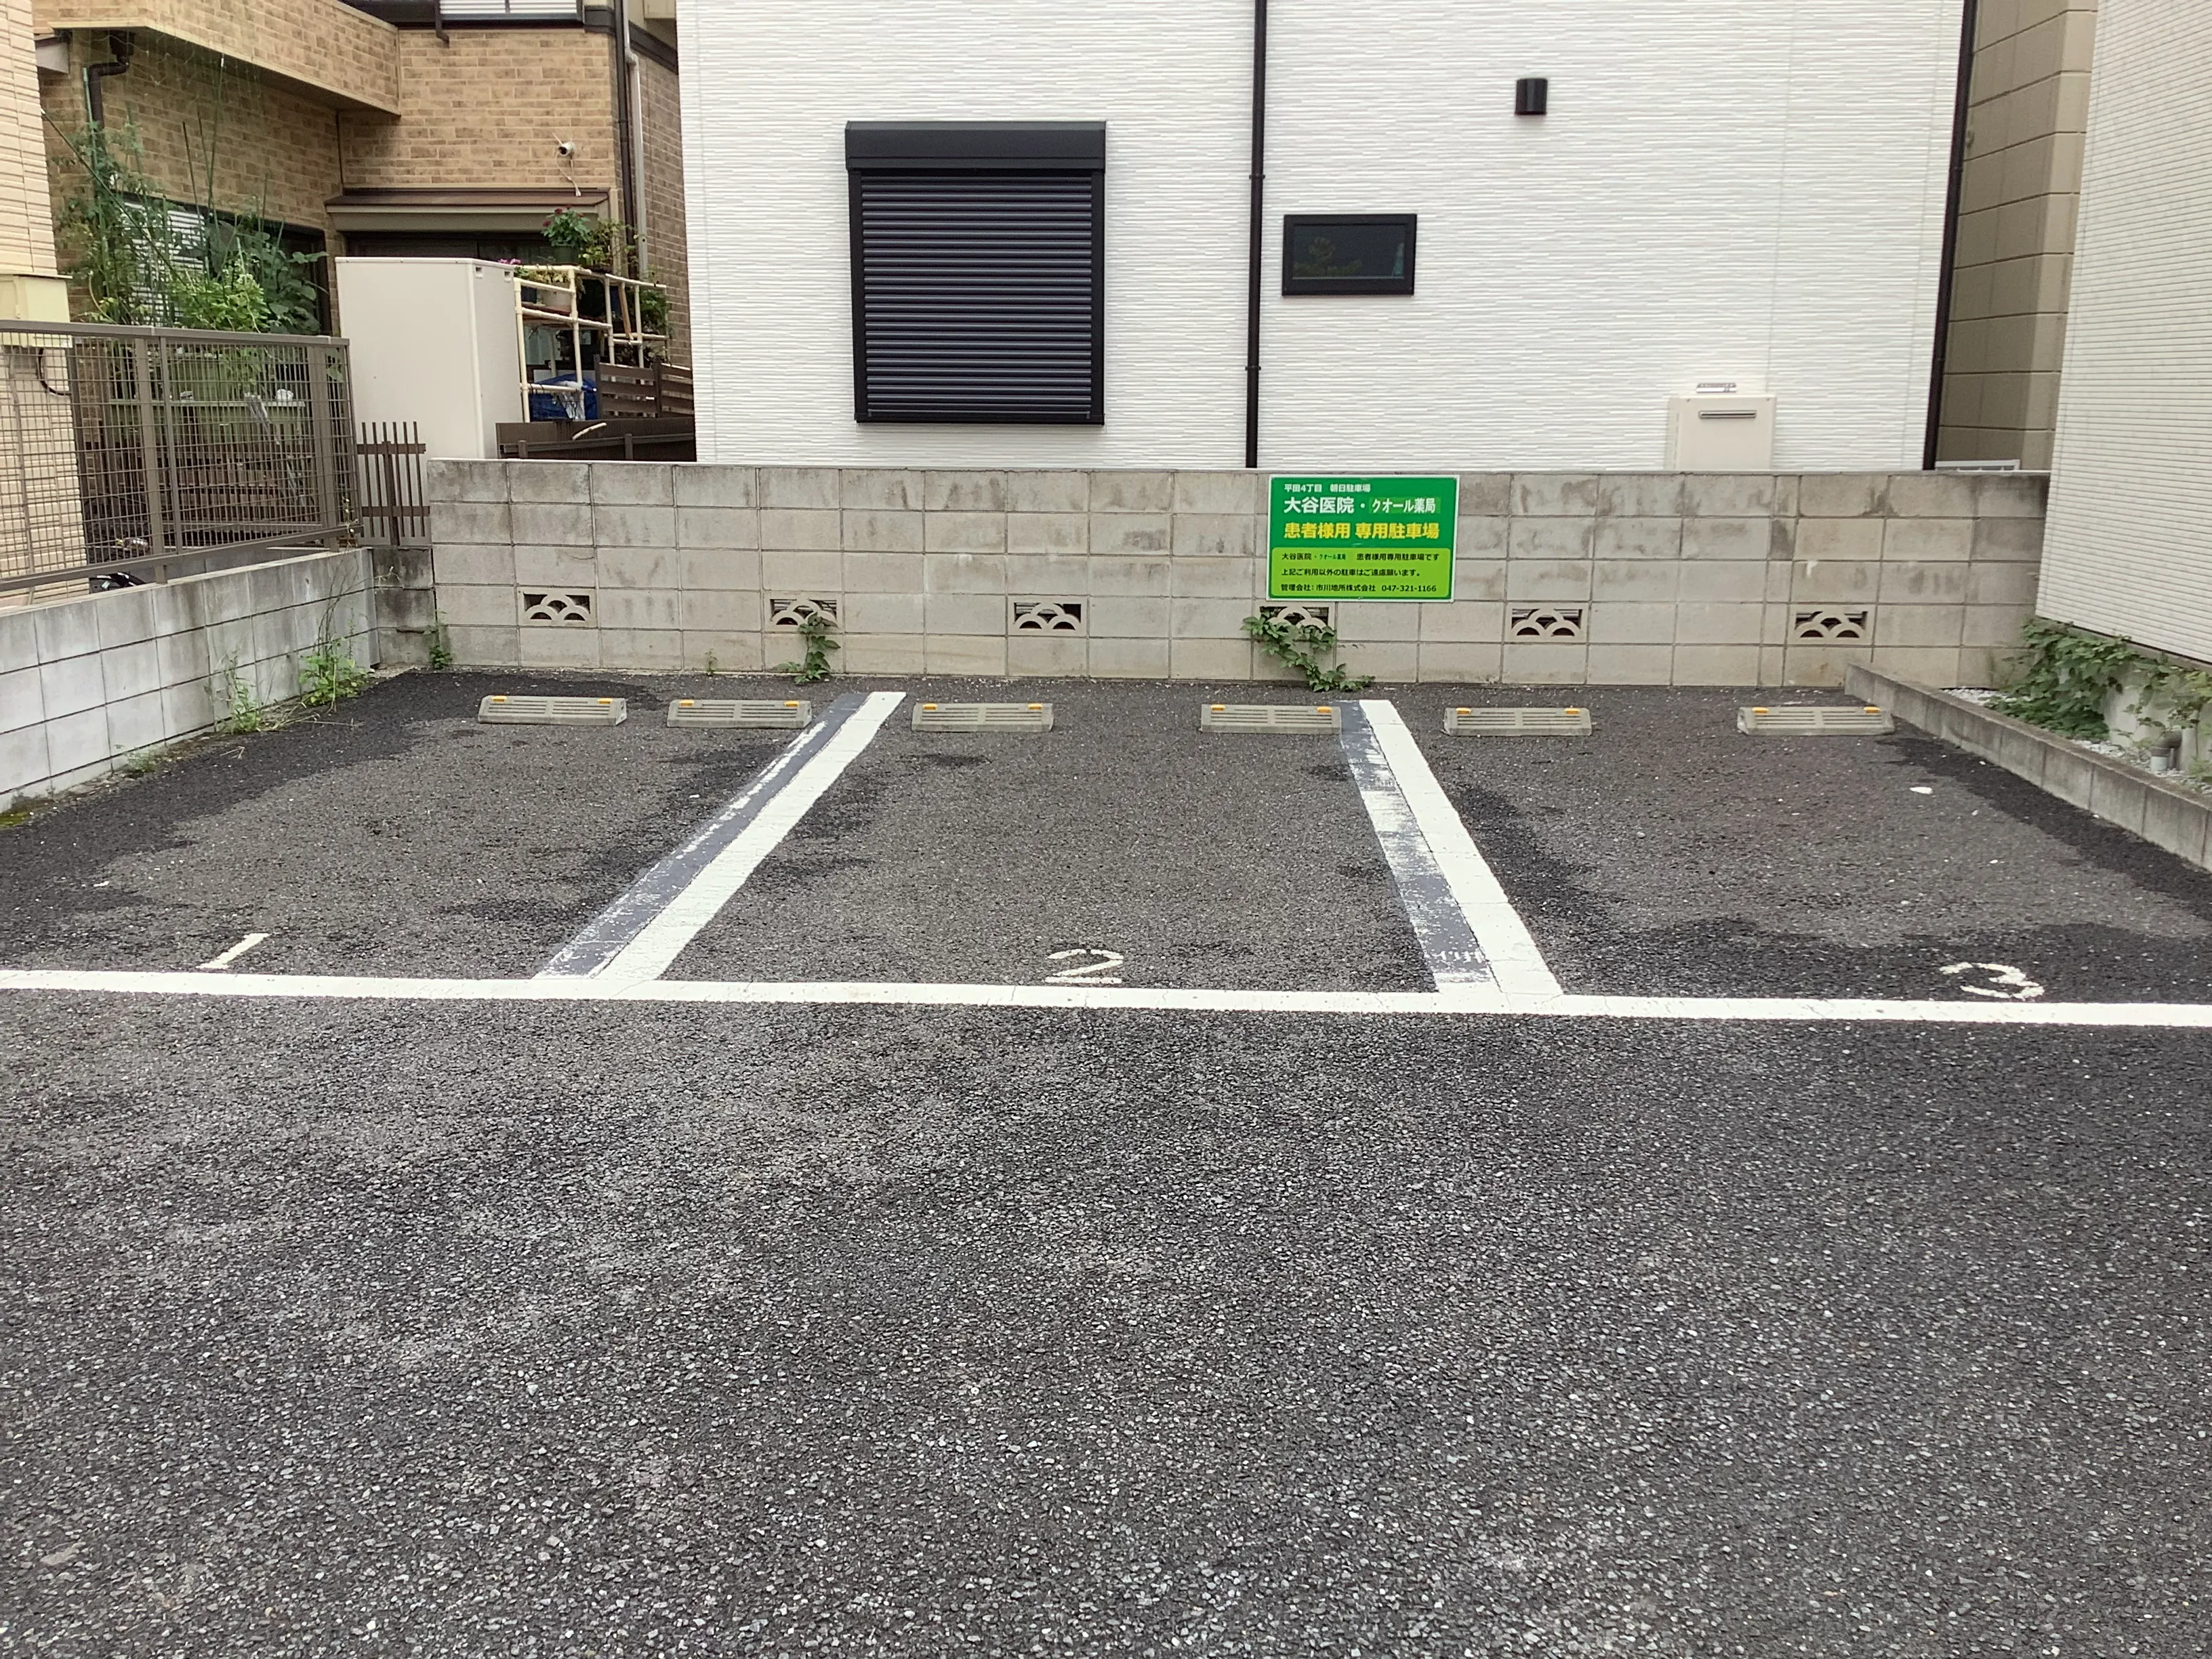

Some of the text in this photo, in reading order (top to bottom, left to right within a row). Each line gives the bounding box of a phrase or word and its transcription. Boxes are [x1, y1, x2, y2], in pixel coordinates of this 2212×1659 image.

[1284, 483, 1322, 493] 平田4丁目
[1284, 522, 1439, 539] 患者様用 専用駐車場
[196, 933, 272, 969] 1
[1045, 949, 1124, 983] 2
[1939, 962, 2045, 1000] 3
